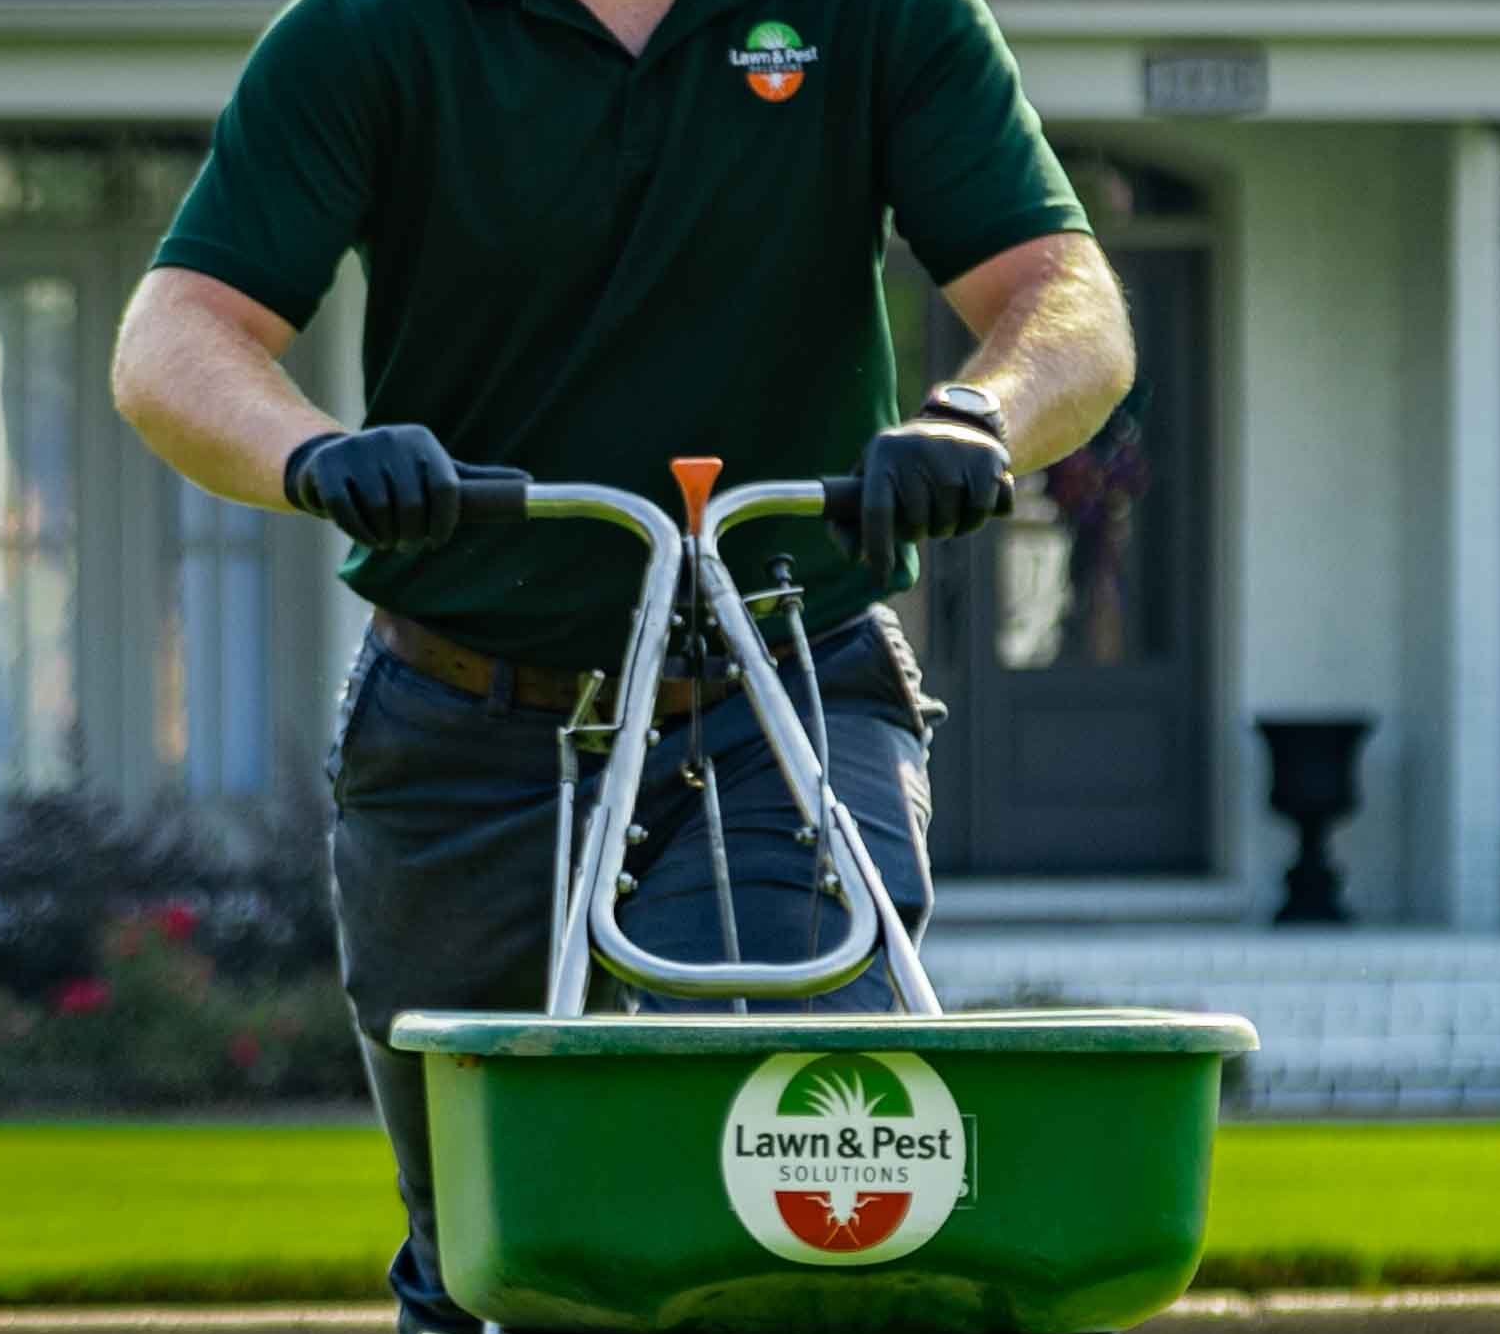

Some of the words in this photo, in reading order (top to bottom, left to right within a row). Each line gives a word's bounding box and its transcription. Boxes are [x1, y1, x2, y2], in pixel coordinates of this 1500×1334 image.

[735, 1124, 829, 1158] Lawn
[837, 1127, 866, 1159] &
[872, 1126, 952, 1160] Pest
[778, 1165, 909, 1183] SOLUTIONS
